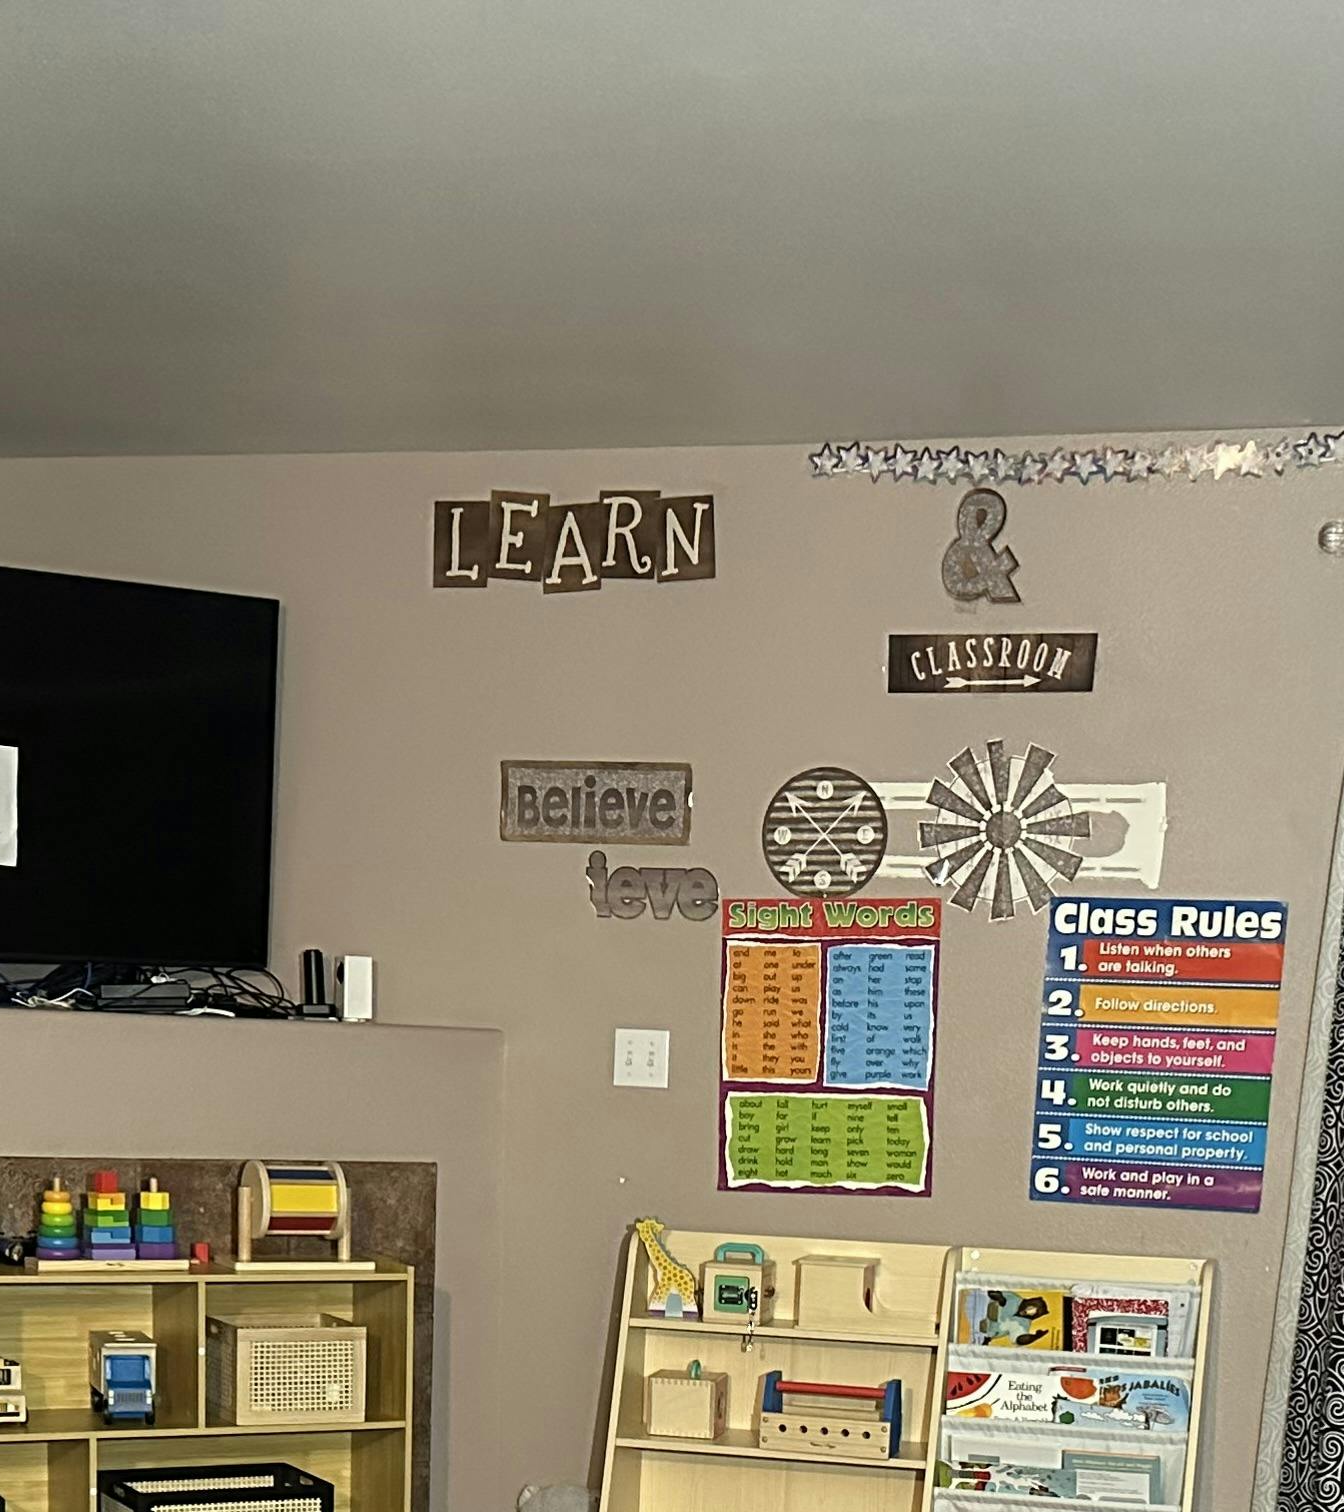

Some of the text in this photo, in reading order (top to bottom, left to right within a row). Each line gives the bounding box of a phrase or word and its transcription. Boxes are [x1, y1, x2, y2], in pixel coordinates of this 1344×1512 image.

[445, 494, 711, 587] LEARN
[941, 487, 1021, 603] &
[910, 636, 1072, 682] CLASSROOM
[728, 901, 935, 930] Sight Words
[1054, 902, 1282, 939] Class Rules
[1061, 943, 1230, 971] 1. Listen when others
[1098, 961, 1177, 976] are talking.
[1047, 991, 1217, 1017] 2. Follow directions.
[1045, 1035, 1245, 1062] 3. Keep hands, feet, and
[1091, 1051, 1225, 1068] objects to yourself.
[1041, 1079, 1231, 1106] 4. Work quietly and do
[1087, 1096, 1214, 1112] not disturb others.
[1038, 1124, 1252, 1151] 5. Show respect for school
[1084, 1140, 1247, 1161] and personal property.
[1034, 1168, 1214, 1194] 6. Work and play in a
[1081, 1184, 1170, 1201] safe manner.
[1008, 1380, 1043, 1394] Eating
[1017, 1393, 1033, 1402] the
[1000, 1402, 1050, 1413] Alphabet
